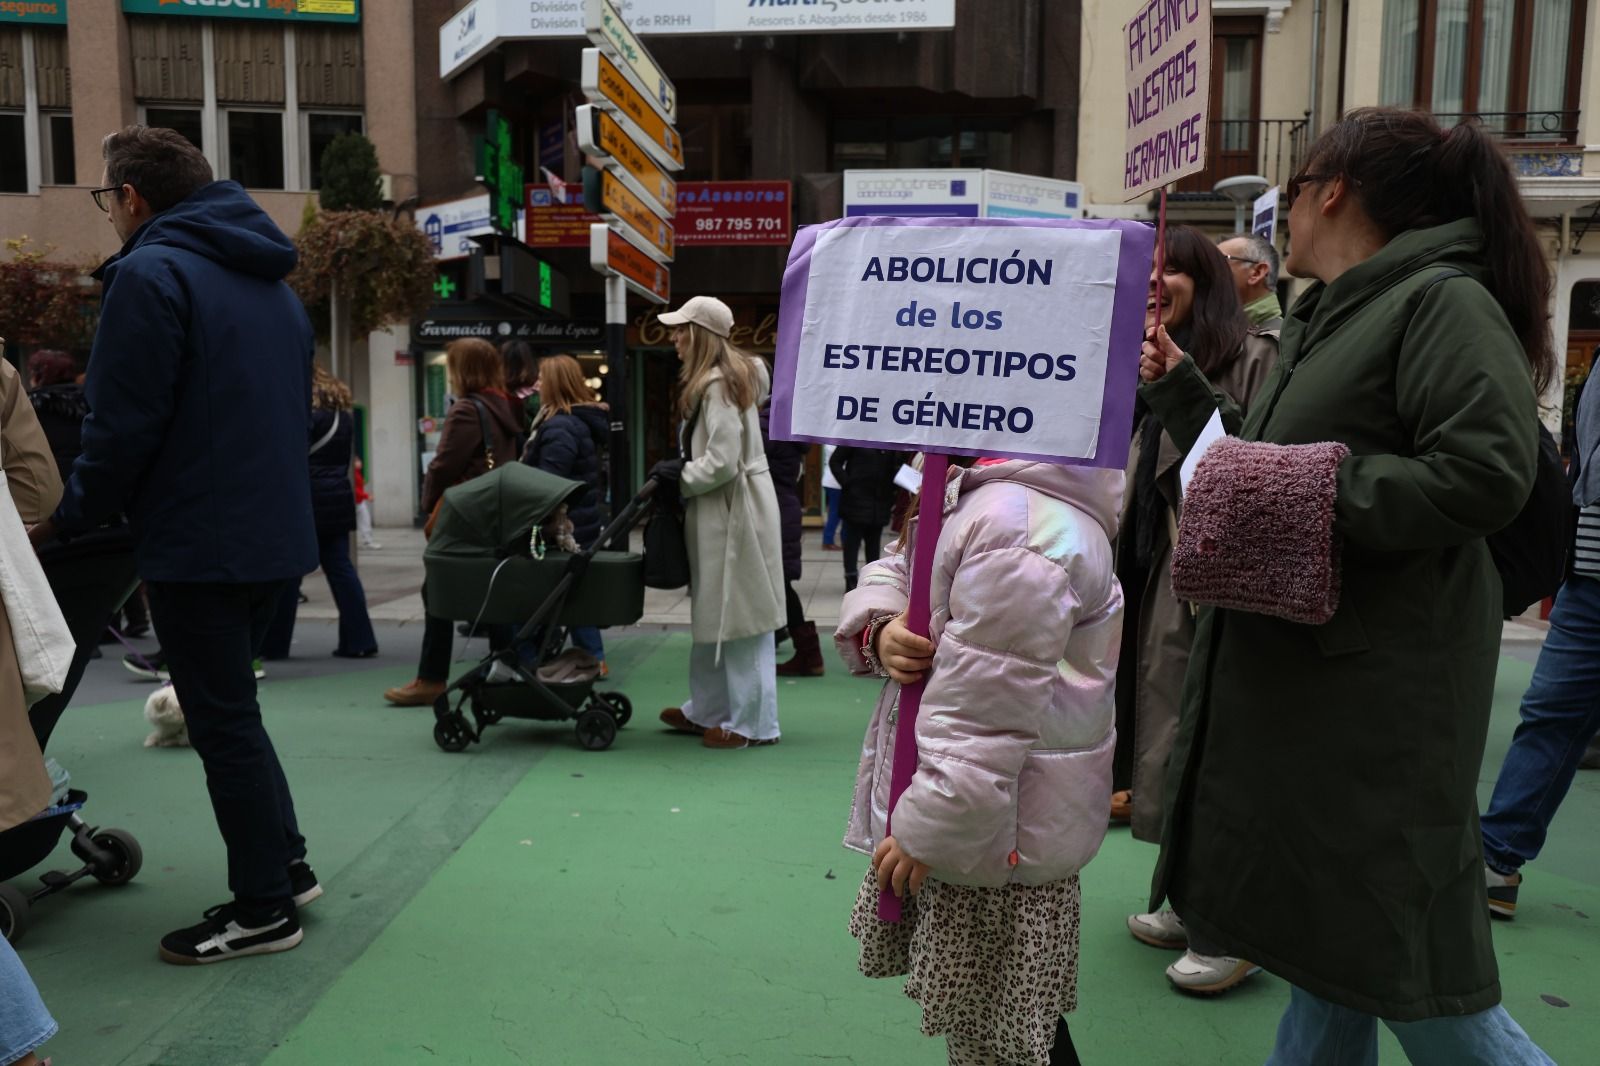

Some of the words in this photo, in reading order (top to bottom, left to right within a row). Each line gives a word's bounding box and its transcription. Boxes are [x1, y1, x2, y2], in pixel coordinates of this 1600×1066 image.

[530, 1, 577, 13] División
[748, 16, 795, 26] Asesores
[799, 15, 806, 25] &
[810, 14, 861, 26] Abogados
[864, 13, 896, 23] desde
[900, 12, 927, 22] 1986
[531, 17, 578, 29] División
[636, 15, 650, 26] de
[654, 15, 691, 26] RRHH
[1128, 39, 1196, 129] NUESTRAS
[1124, 113, 1201, 190] HERMANAS
[696, 218, 722, 230] 987
[726, 218, 752, 230] 795
[757, 218, 781, 230] 701
[861, 249, 1053, 286] ABOLICIÓN
[419, 320, 492, 336] Farmacia
[517, 324, 531, 335] de
[532, 323, 563, 336] Mata
[896, 301, 937, 327] de
[951, 302, 1003, 330] los
[823, 344, 1077, 381] ESTEREOTIPOS
[836, 395, 880, 423] DE
[892, 392, 1034, 433] GÉNERO
